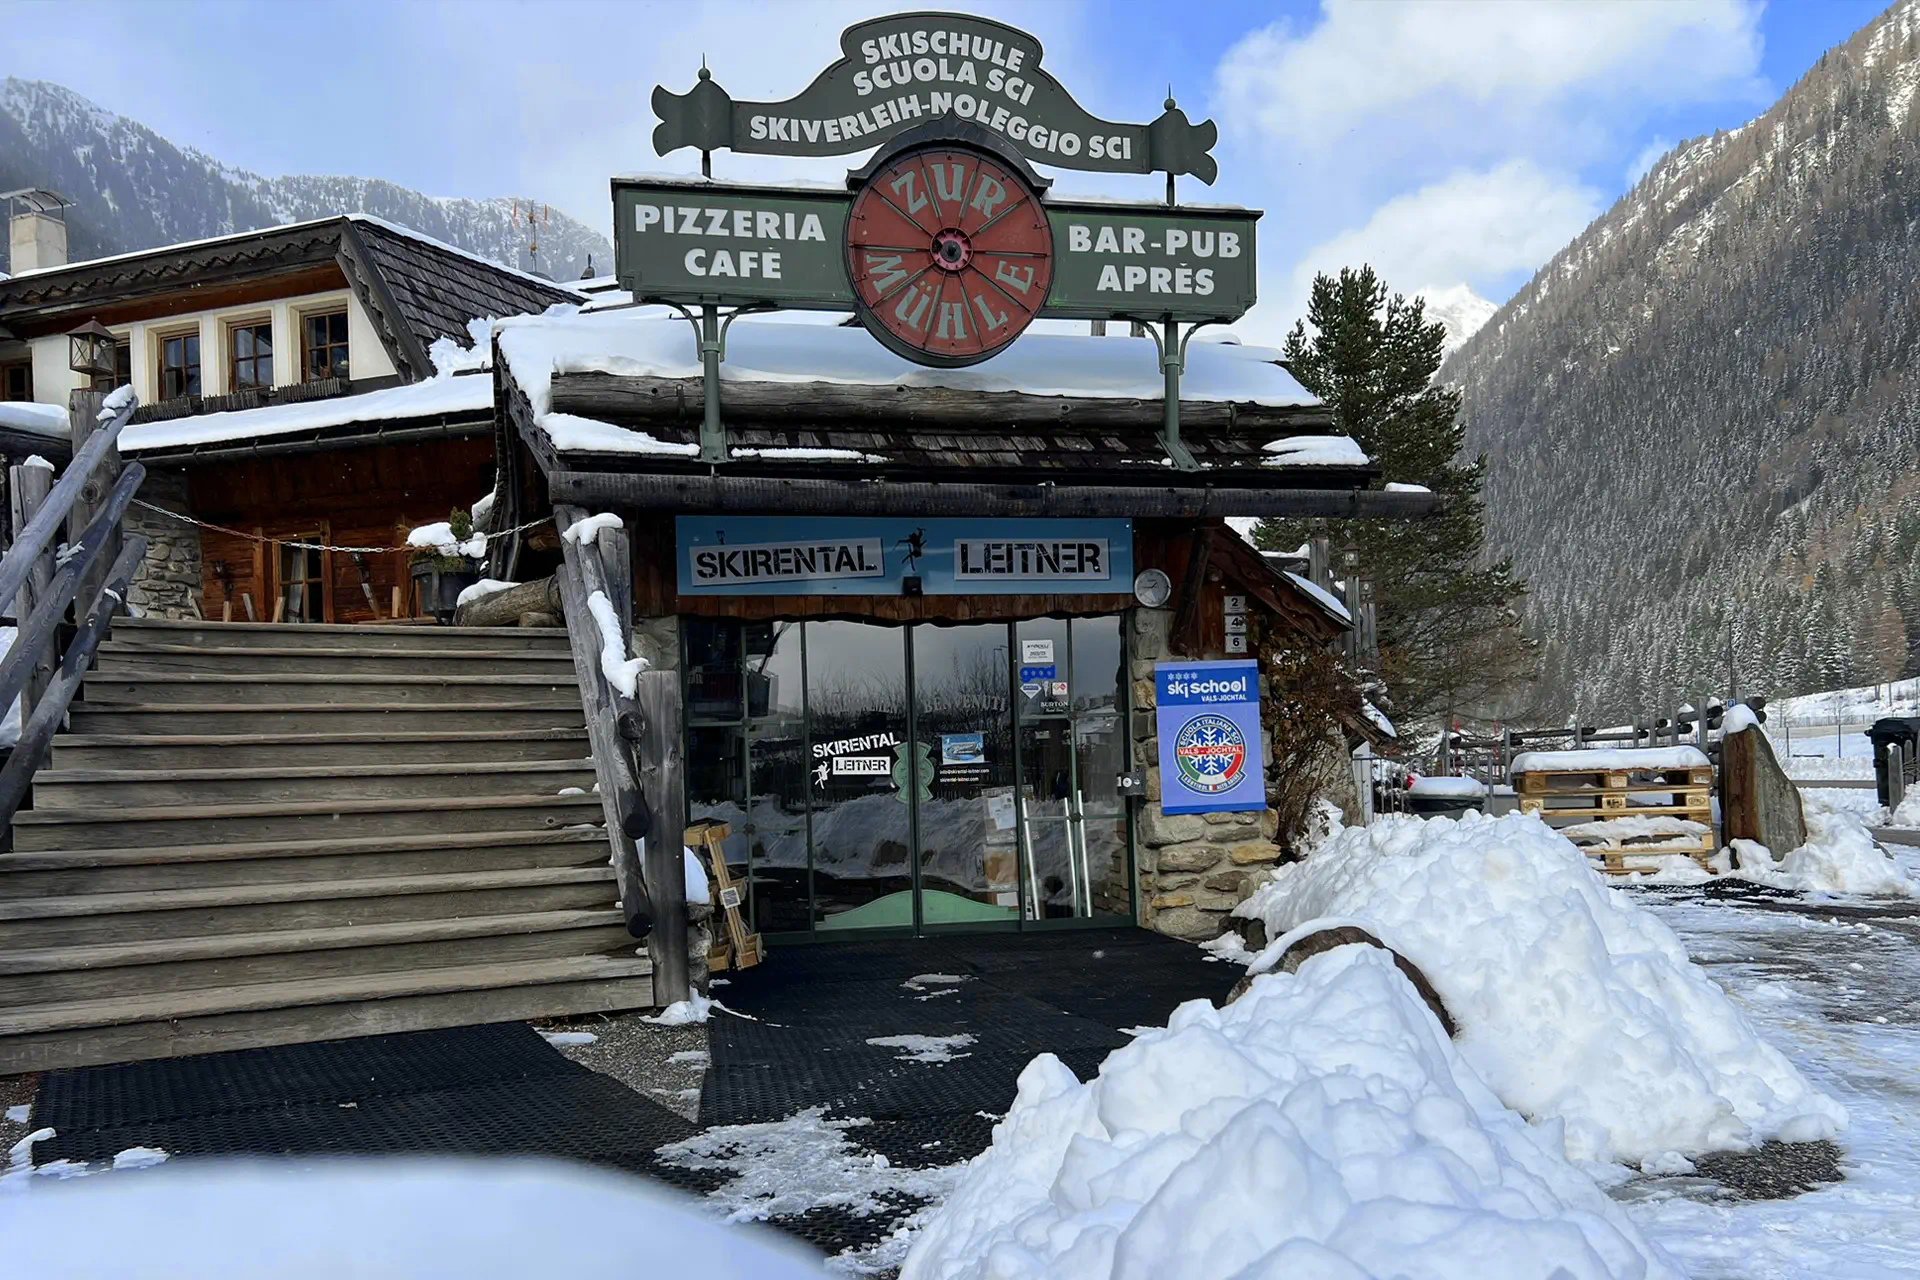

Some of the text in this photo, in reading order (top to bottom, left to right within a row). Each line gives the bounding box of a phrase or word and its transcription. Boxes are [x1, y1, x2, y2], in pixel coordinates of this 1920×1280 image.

[861, 30, 1025, 73] SKISCHULE
[853, 58, 1035, 106] SCUOLA SCI
[750, 92, 1131, 160] SKIVERLEIH-NOLEGGIO SCI
[891, 163, 1006, 218] ZUR
[635, 204, 826, 241] PIZZERIA
[865, 254, 1034, 340] MÜHLE
[696, 543, 1102, 579] SKIRENTAL LEITNER
[1231, 597, 1239, 607] 2
[1231, 617, 1240, 626] 4
[1232, 637, 1240, 647] 6
[1201, 694, 1247, 702] VALS-JOCHTAL
[812, 732, 901, 758] SKIRENTAL
[1180, 719, 1240, 746] SCUOLA ITALIANA SCI
[1206, 746, 1240, 754] JOCHTAL
[835, 759, 887, 771] LEITNER
